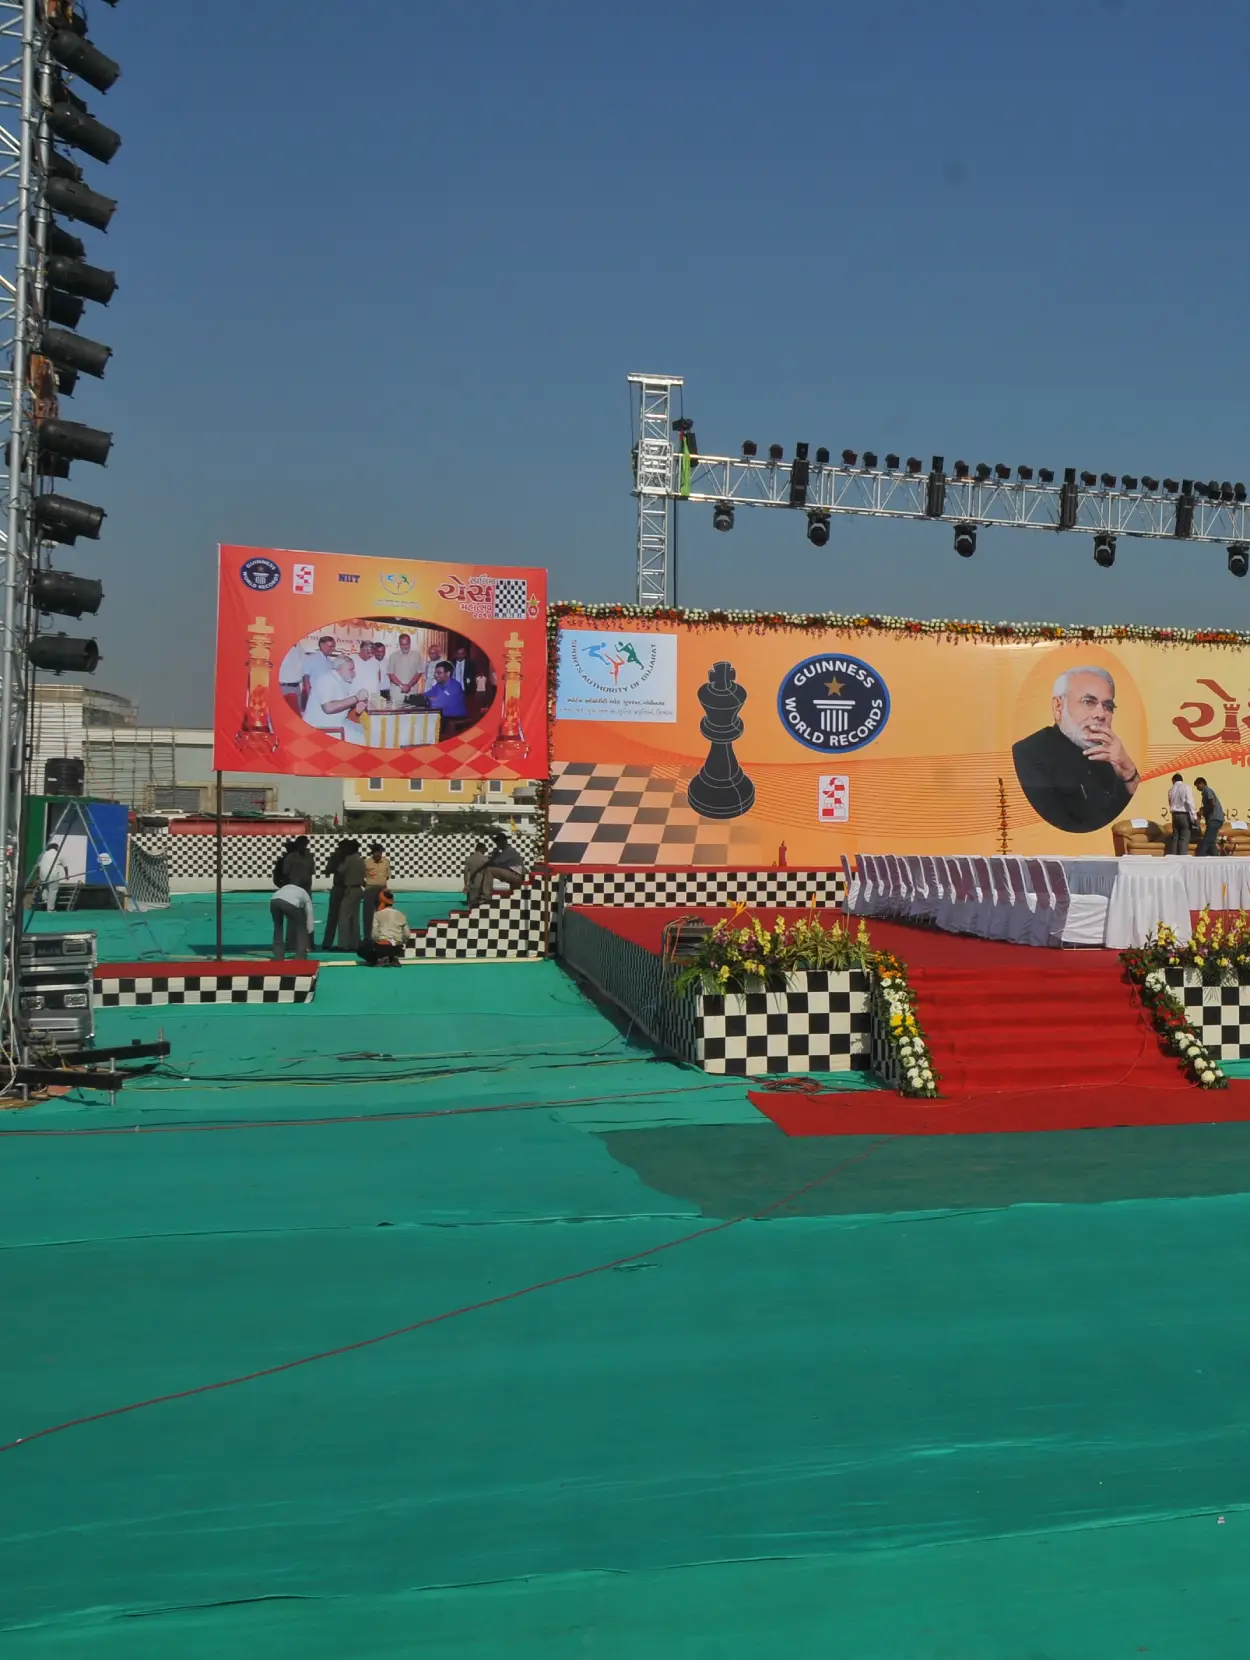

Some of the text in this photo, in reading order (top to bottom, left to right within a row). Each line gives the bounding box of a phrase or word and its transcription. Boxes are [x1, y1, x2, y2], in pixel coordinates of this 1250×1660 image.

[338, 573, 360, 583] NIIT
[437, 575, 492, 602] ચેસ
[582, 675, 628, 693] AUTHORITY
[630, 680, 641, 690] OF
[794, 660, 875, 688] GUINNESS
[785, 697, 883, 746] WORLD RECORDS
